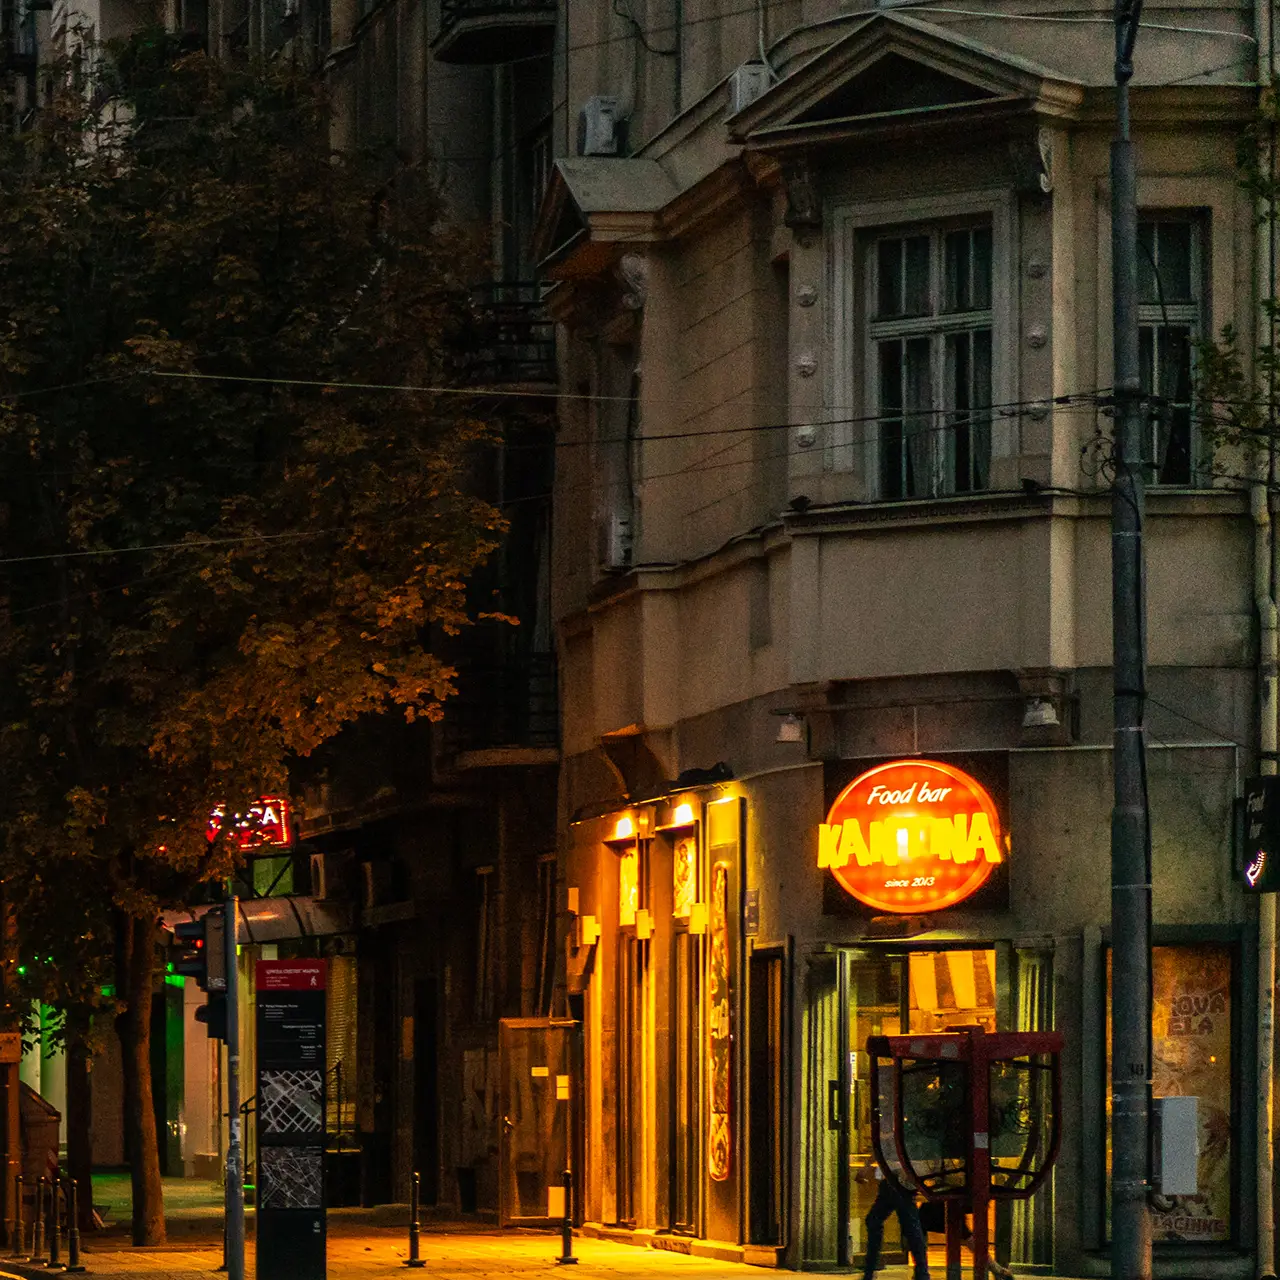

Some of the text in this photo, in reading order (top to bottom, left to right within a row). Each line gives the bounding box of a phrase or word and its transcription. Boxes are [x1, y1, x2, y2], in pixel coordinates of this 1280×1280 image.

[867, 781, 952, 805] Food bar
[884, 876, 935, 888] since 2013
